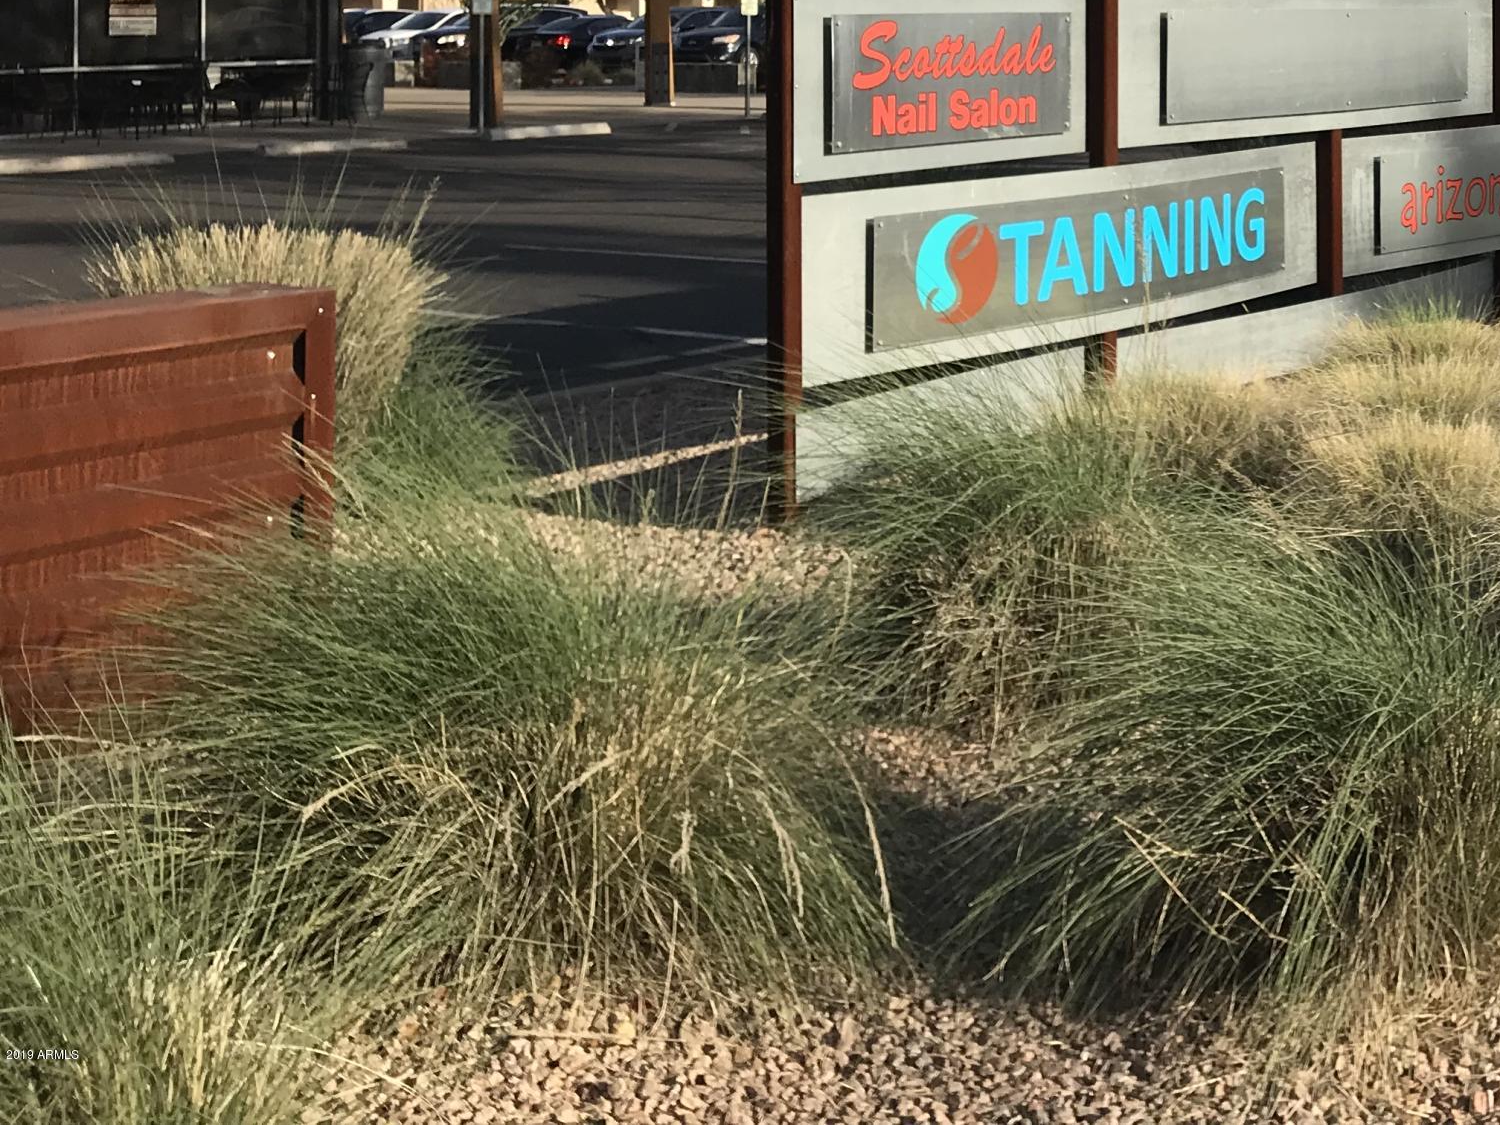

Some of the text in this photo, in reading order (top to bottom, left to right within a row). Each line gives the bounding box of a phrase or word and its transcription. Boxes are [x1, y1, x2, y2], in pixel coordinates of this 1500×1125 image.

[852, 20, 1057, 89] Scottsdale
[872, 88, 1038, 137] Nail Salon
[1000, 187, 1265, 306] TANNING
